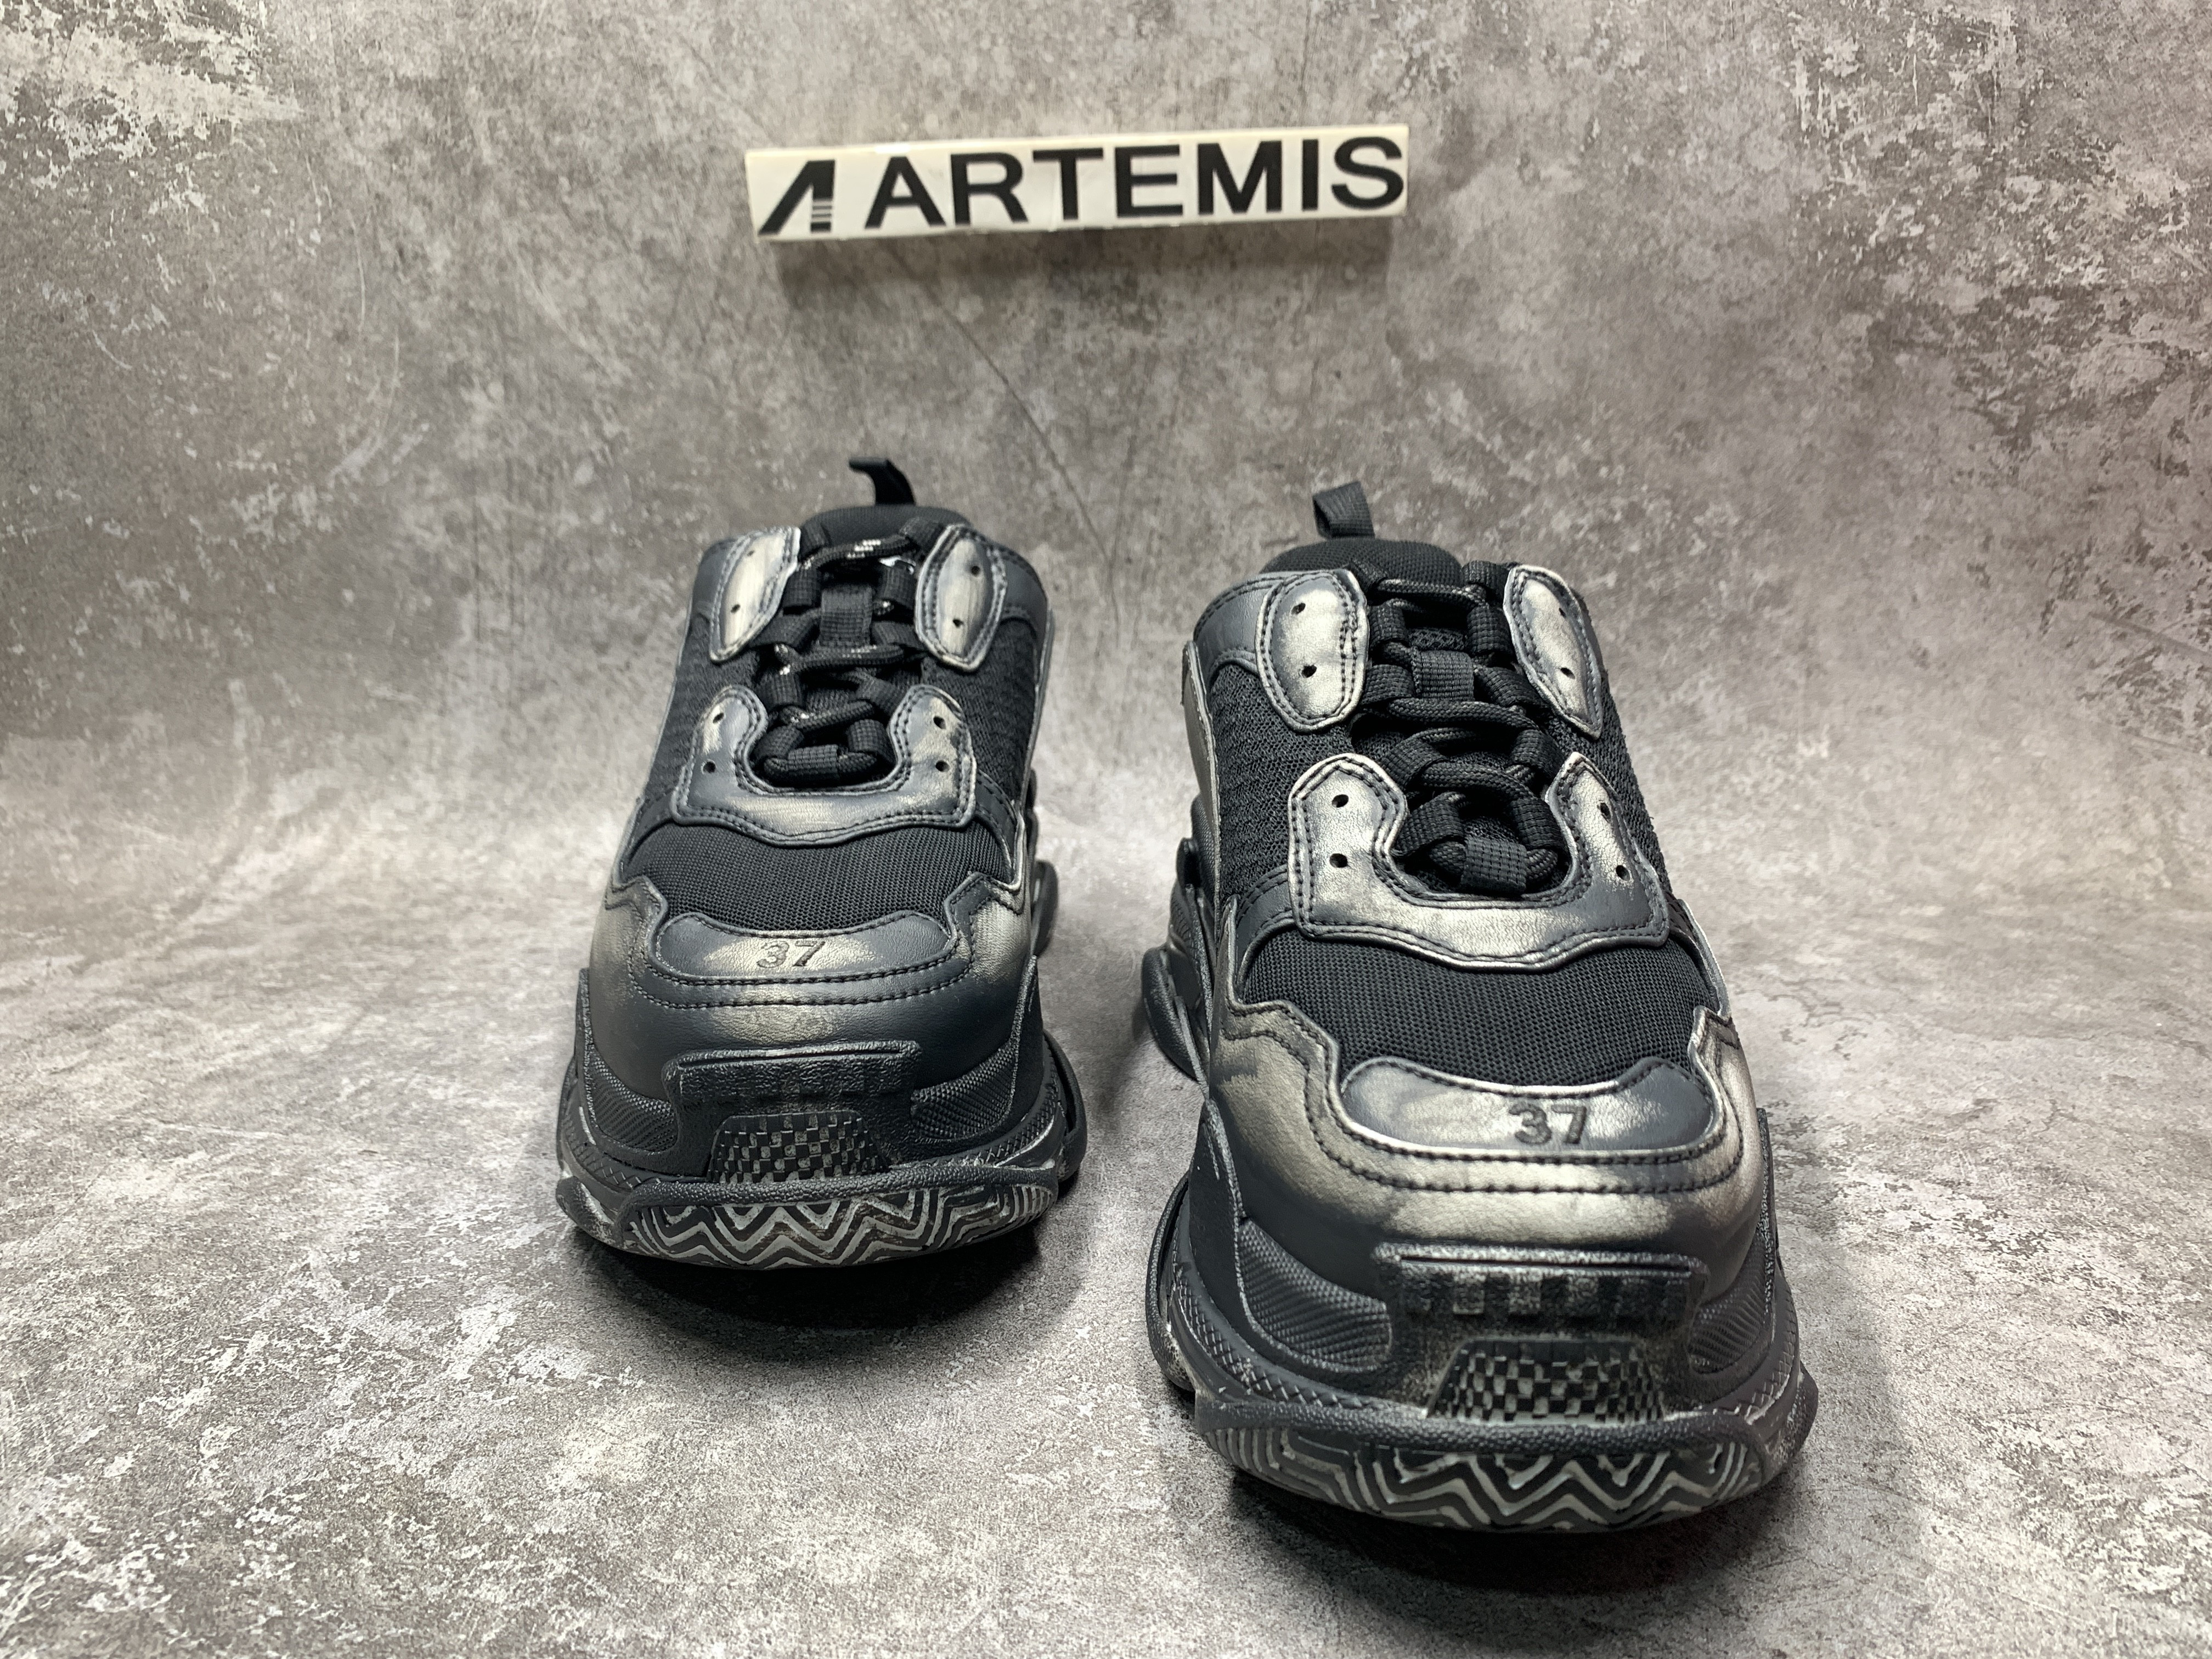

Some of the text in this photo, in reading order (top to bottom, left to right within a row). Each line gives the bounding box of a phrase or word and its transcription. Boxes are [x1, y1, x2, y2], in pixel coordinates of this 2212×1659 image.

[865, 136, 1404, 228] ARTEMIS
[757, 940, 825, 968] 37
[1509, 1103, 1587, 1144] 37
